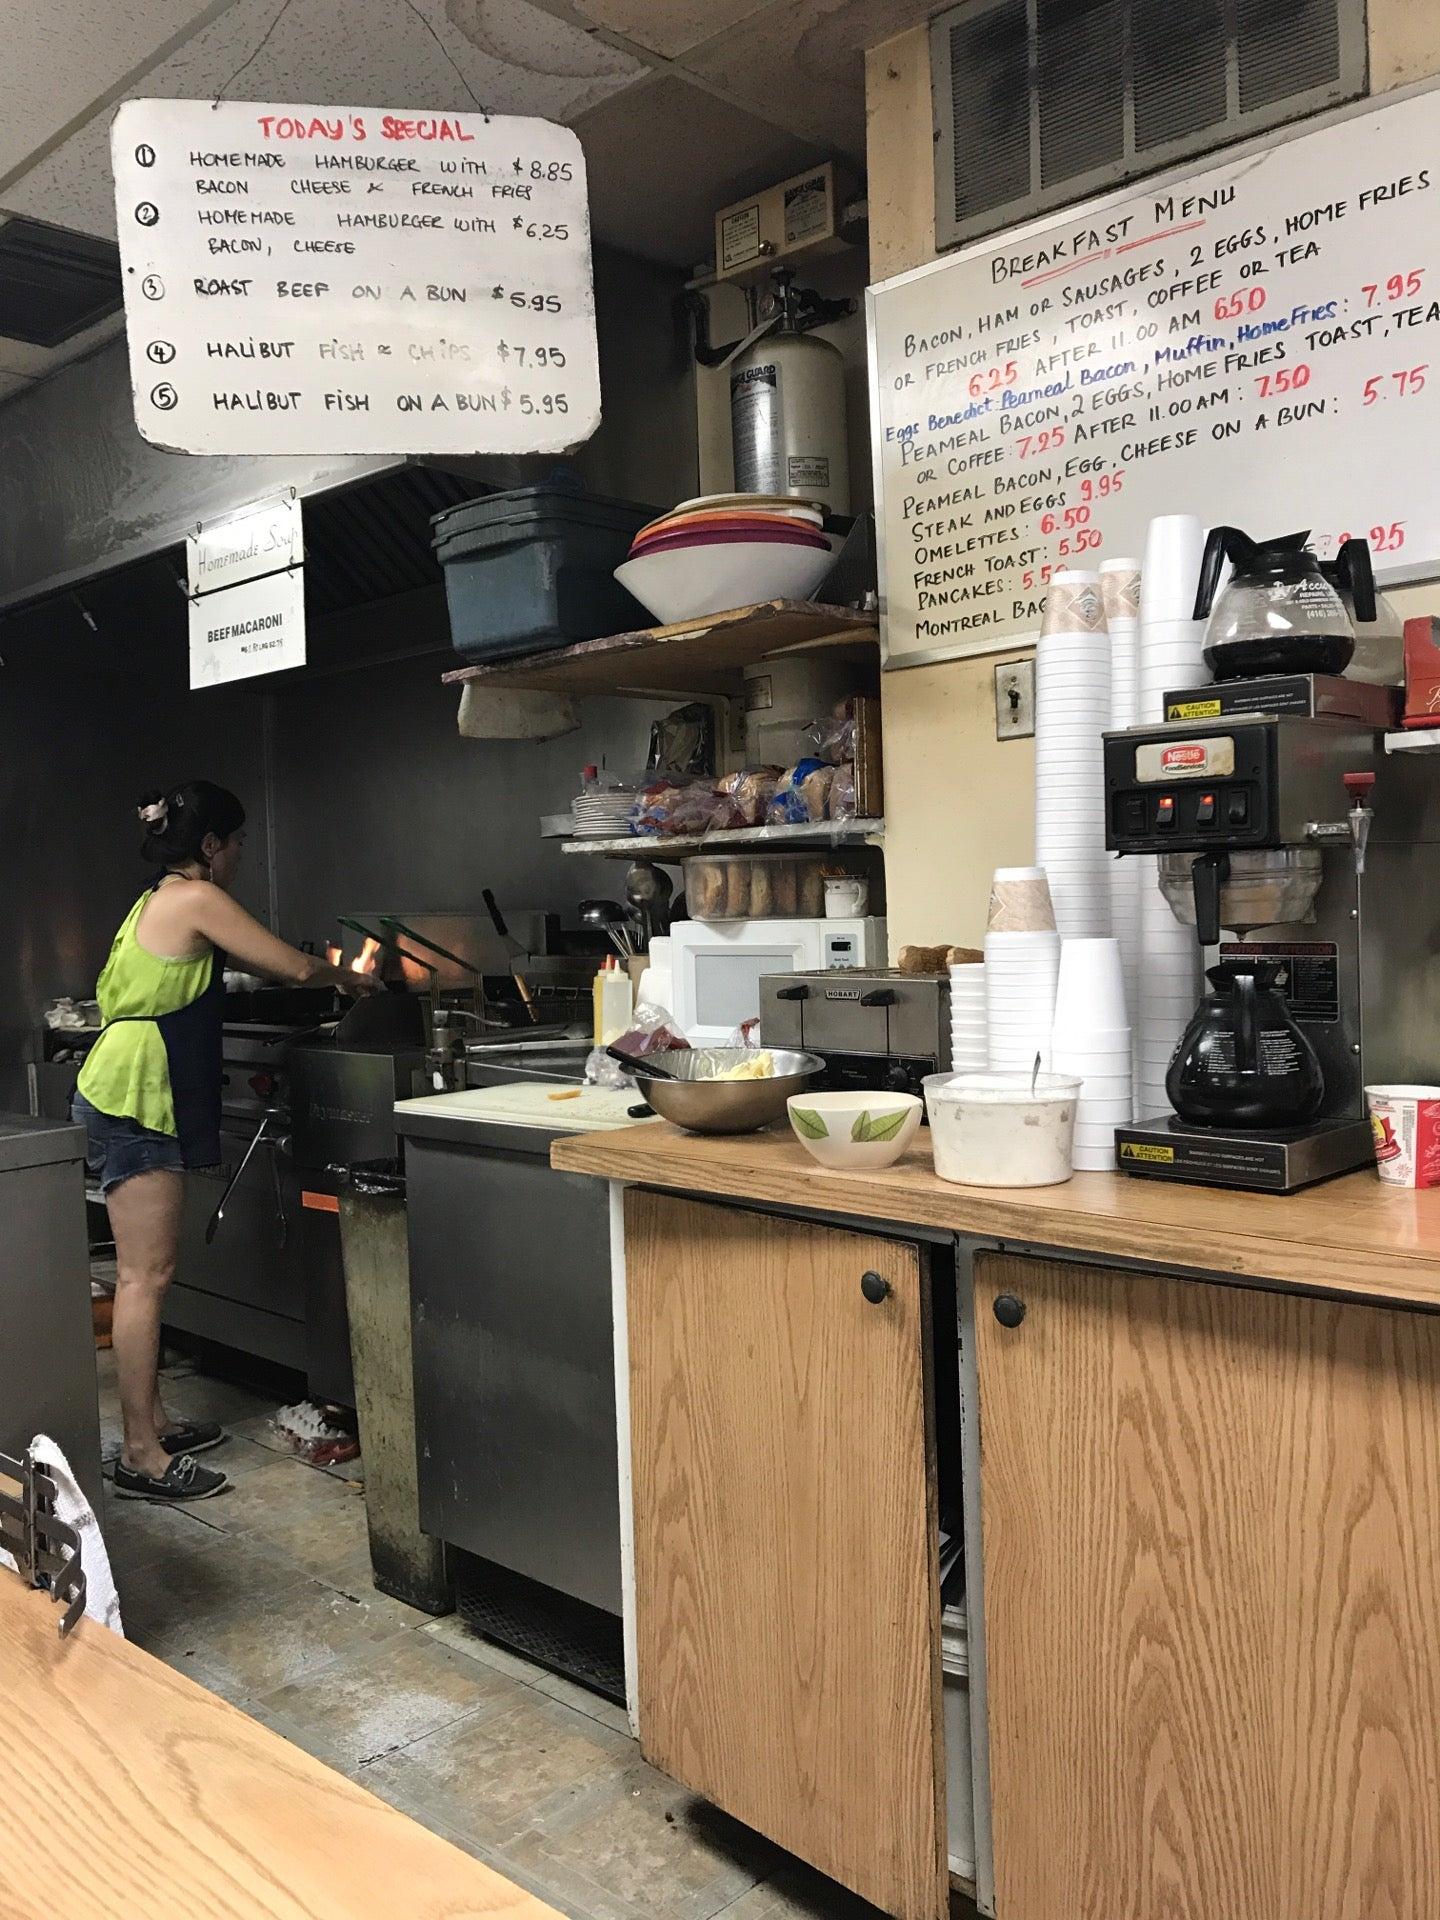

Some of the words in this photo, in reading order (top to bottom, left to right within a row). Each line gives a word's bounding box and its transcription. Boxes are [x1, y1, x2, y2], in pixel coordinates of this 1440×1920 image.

[258, 114, 366, 141] TODAY'S
[380, 119, 475, 141] SPECIAL
[190, 151, 286, 169] HOMEMADE
[315, 157, 420, 173] HAMBURGER
[197, 179, 248, 195] BACON
[291, 179, 350, 195] CHEESE
[412, 182, 473, 199] FRENCH
[492, 183, 533, 200] FRIES
[198, 210, 295, 227] HOMEMADE
[338, 213, 444, 230] HAMBURGER
[991, 216, 1134, 284] BREAKFAST
[1155, 186, 1236, 223] MENU
[294, 239, 355, 255] CHEESE
[979, 306, 1019, 333] HAM
[1030, 298, 1053, 316] OR
[1190, 246, 1204, 267] 2
[1285, 201, 1347, 235] HOME
[1359, 170, 1430, 211] FRIES
[194, 277, 253, 297] ROAST
[277, 281, 330, 299] BEEF
[352, 284, 381, 300] ON
[400, 285, 416, 301] A
[426, 284, 466, 302] BUN
[894, 373, 916, 391] OR
[926, 351, 987, 380] FRENCH
[1147, 269, 1223, 308] COFFEE
[1240, 261, 1269, 279] OR
[1275, 241, 1321, 268] TEA
[886, 423, 920, 444] Eggs
[1361, 268, 1426, 308] 7.95
[1035, 342, 1102, 376] AFTER
[1168, 310, 1201, 334] AM
[397, 395, 421, 412] ON
[431, 394, 448, 411] A
[455, 394, 497, 412] BUN
[901, 428, 990, 467] PEAMEAL
[1071, 394, 1084, 417] 2
[1157, 361, 1218, 391] HOME
[1224, 341, 1286, 374] FRIES
[902, 485, 986, 520] PEAMEAL
[1120, 429, 1199, 462] CHEESE
[1211, 420, 1241, 441] ON
[1255, 414, 1270, 431] A
[1362, 364, 1429, 406] 5.75
[916, 469, 938, 485] OR
[1015, 425, 1066, 460] 7.25
[1074, 412, 1137, 444] AFTER
[912, 513, 974, 542] STEAK
[1080, 469, 1126, 501] 9.95
[1041, 505, 1091, 535] 6.50
[199, 532, 259, 575] Homemade
[264, 524, 298, 557] Soup
[914, 563, 976, 590] FRENCH
[1059, 528, 1104, 556] 5.50
[915, 609, 1006, 640] MONTREAL
[1183, 709, 1220, 718] ATTENTION
[1185, 702, 1216, 710] CAUTION
[828, 990, 858, 998] HOBART
[1136, 1152, 1172, 1162] ATTENTION
[1139, 1145, 1169, 1155] CAUTION
